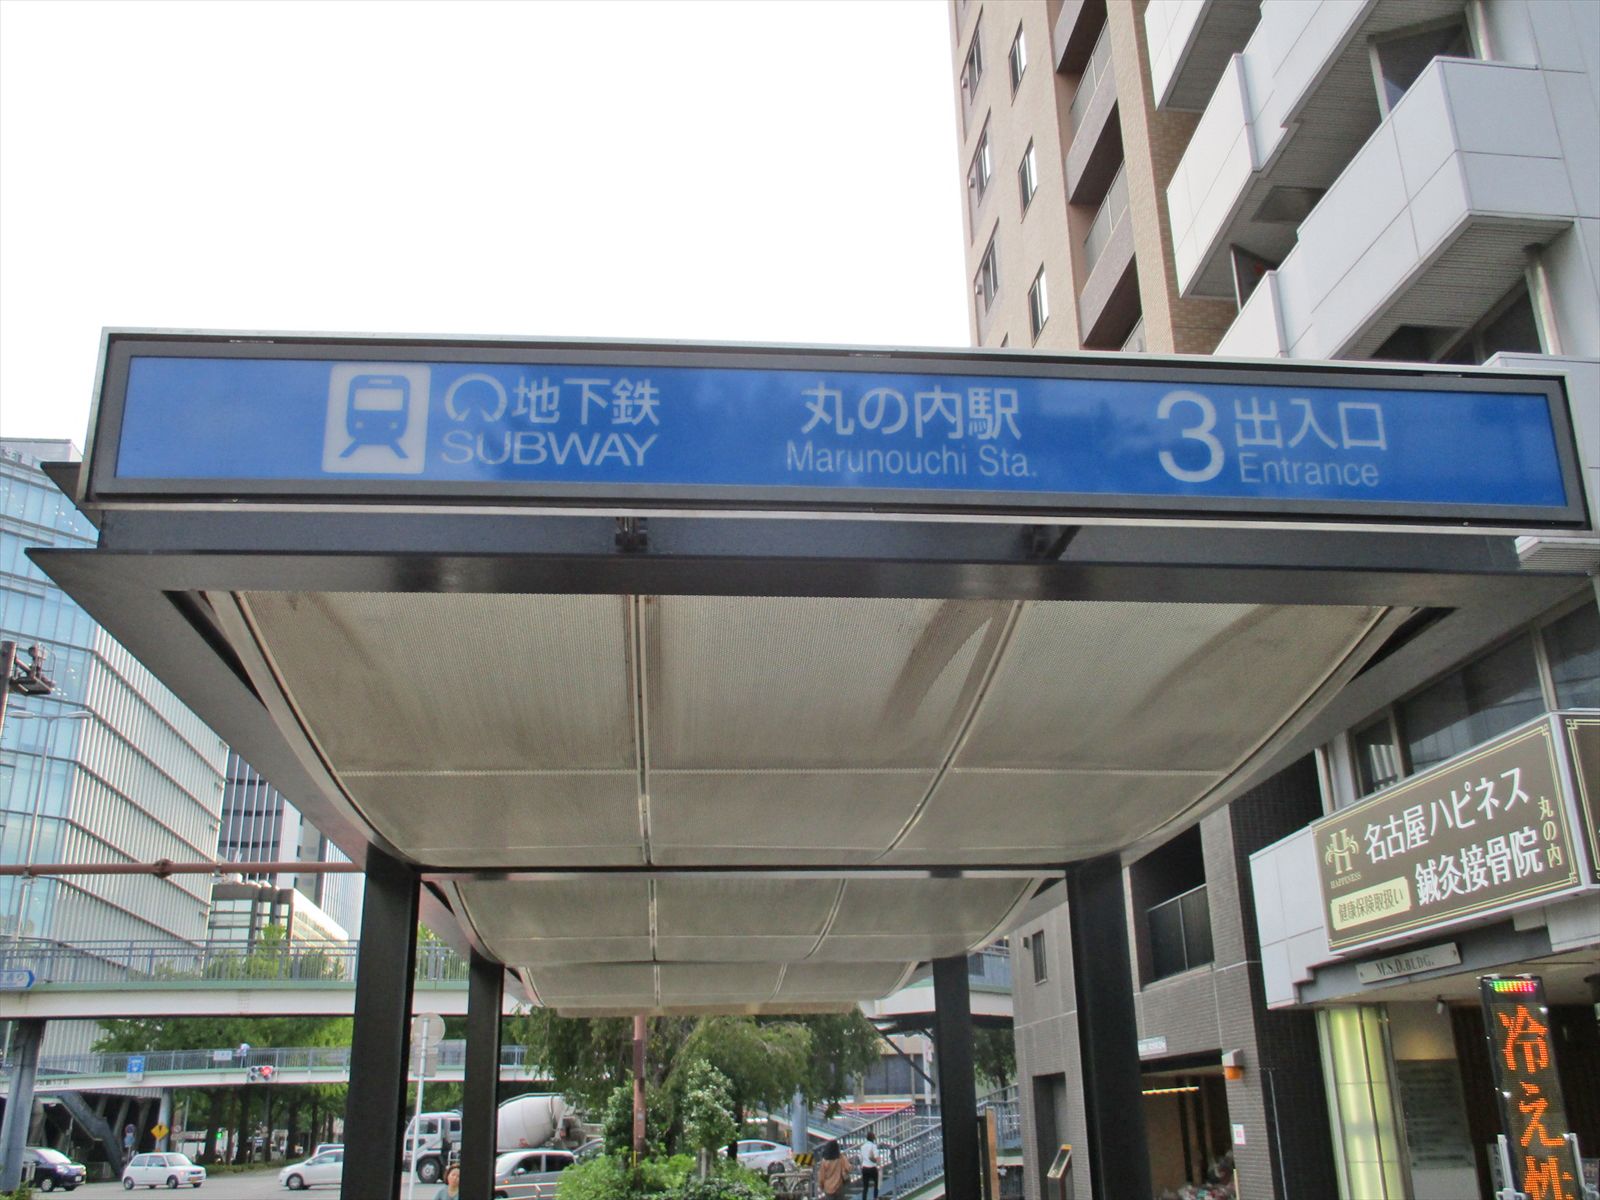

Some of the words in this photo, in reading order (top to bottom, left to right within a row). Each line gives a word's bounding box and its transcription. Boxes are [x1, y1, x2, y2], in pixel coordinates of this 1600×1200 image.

[511, 376, 661, 425] 地下鉄
[801, 381, 1022, 440] 丸の内駅
[1234, 397, 1388, 451] 出入口
[441, 430, 659, 467] SUBWAY
[786, 439, 967, 475] Marunouchi
[978, 443, 1038, 477] Sta.
[1156, 390, 1225, 483] 3
[1238, 452, 1379, 487] Entrance
[1364, 767, 1529, 864] 名古屋ハピネス
[1537, 796, 1563, 869] 丸の内
[1414, 826, 1543, 906] 鍼灸接骨院
